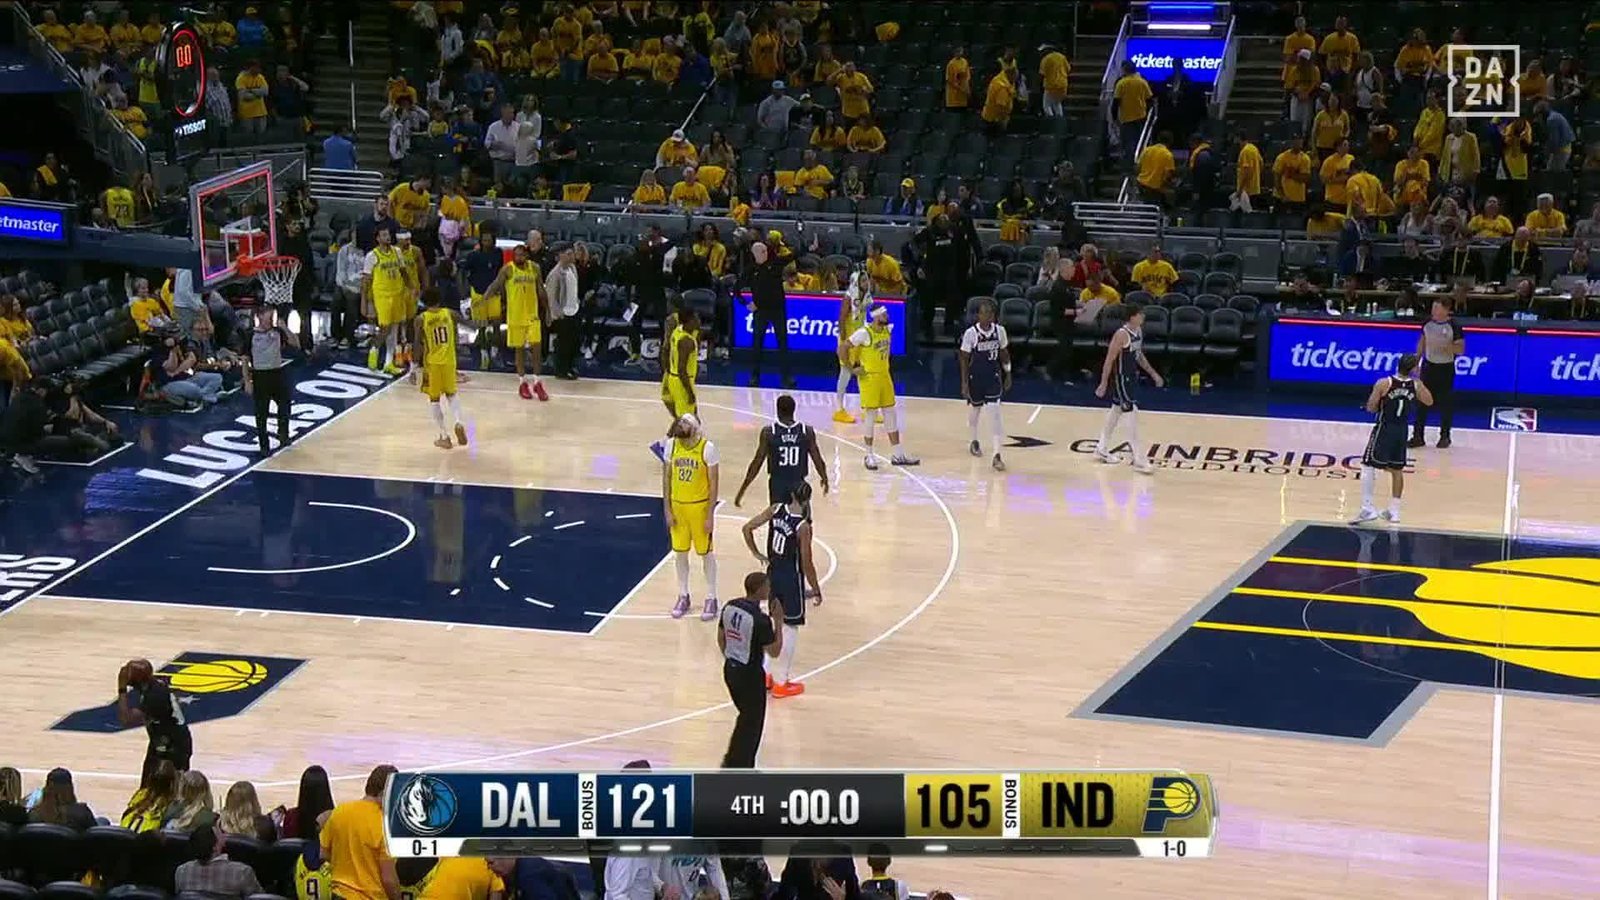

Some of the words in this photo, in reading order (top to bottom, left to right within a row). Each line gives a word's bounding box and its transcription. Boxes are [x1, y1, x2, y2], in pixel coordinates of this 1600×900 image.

[0, 215, 59, 233] tmaster
[1291, 340, 1488, 375] ticketmer
[295, 363, 394, 399] OIL
[779, 446, 800, 466] 30
[772, 529, 787, 554] 10
